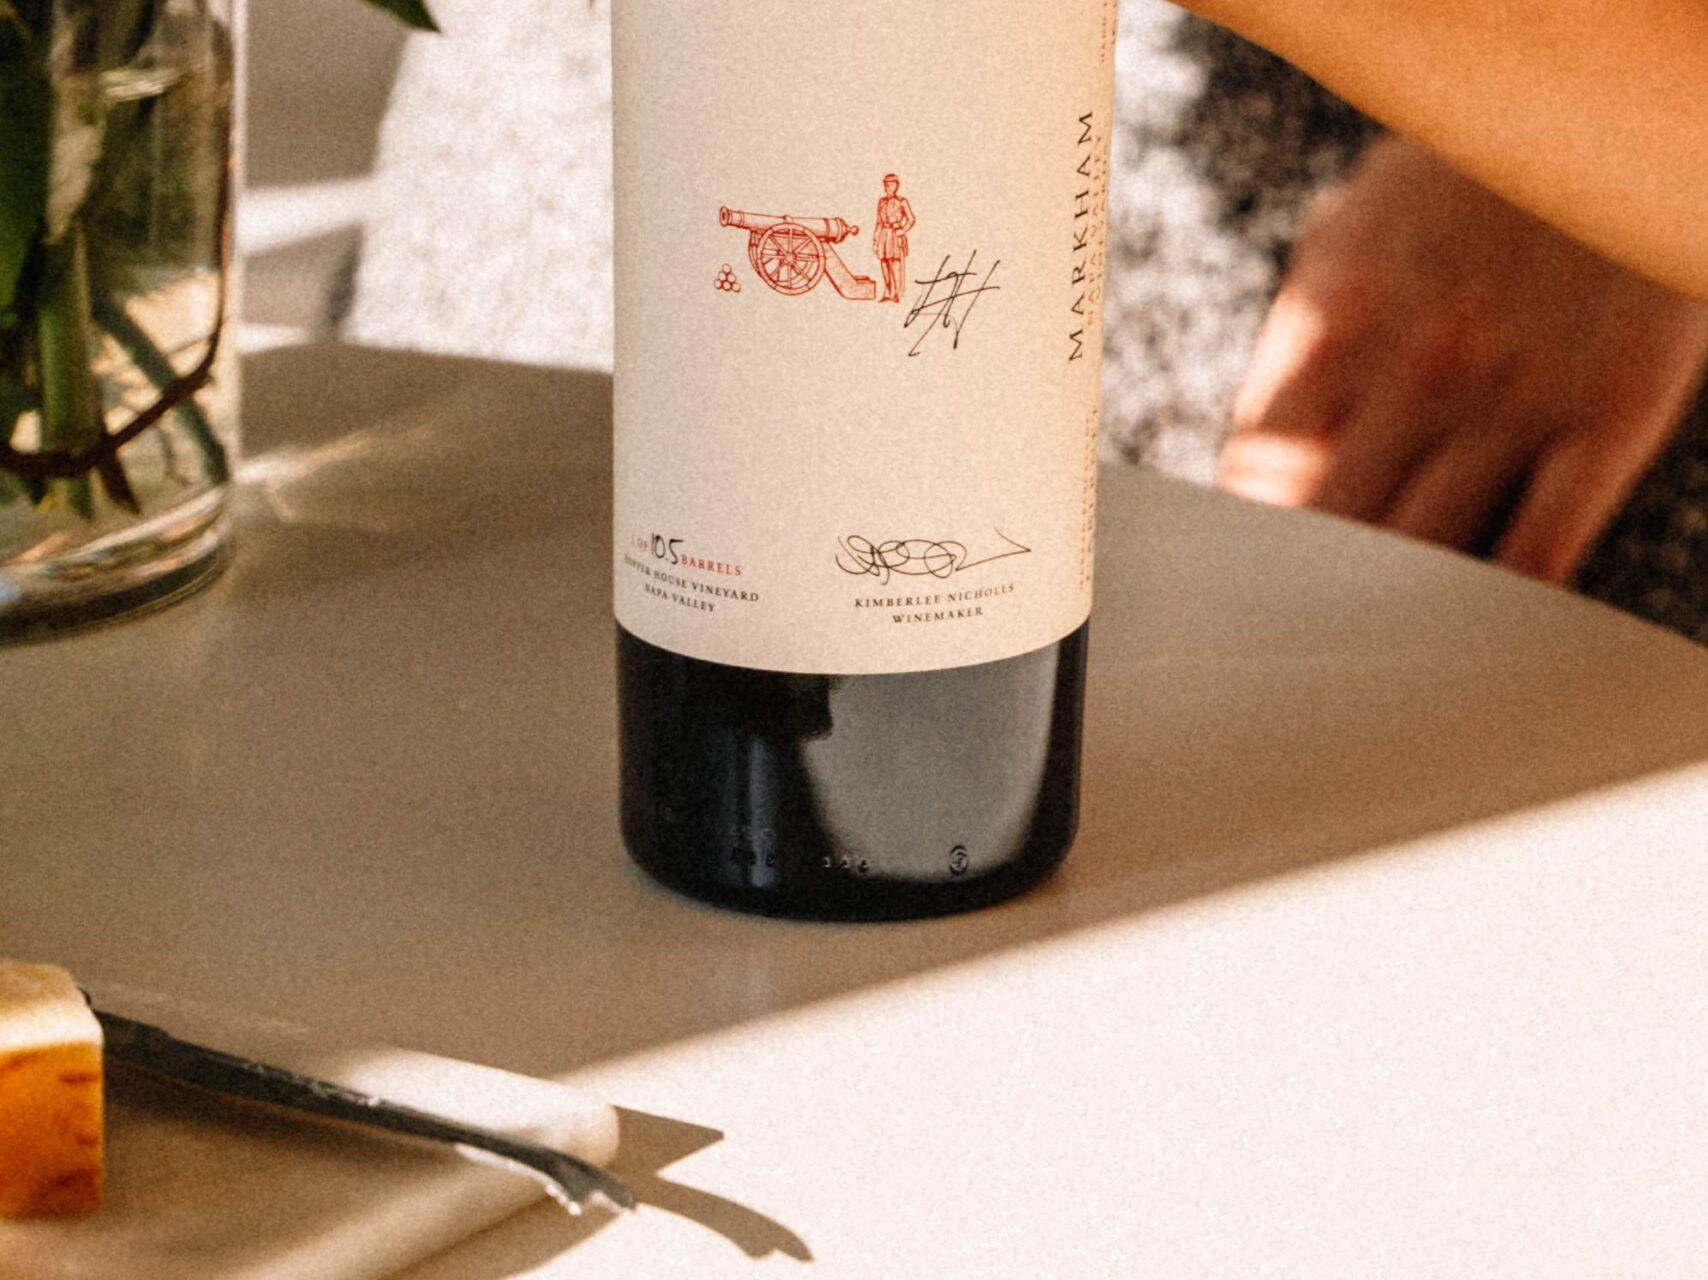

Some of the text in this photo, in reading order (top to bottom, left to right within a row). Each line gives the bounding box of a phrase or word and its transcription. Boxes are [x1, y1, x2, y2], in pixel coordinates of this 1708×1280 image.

[1068, 111, 1093, 362] MARKHAM
[681, 554, 742, 576] BARRELS
[644, 583, 716, 612] NAPA VALLEY
[654, 569, 687, 589] HOUSE
[692, 581, 760, 602] VINEYARD
[855, 583, 1015, 608] KIMBERLEE NICHOLLS
[892, 606, 983, 624] WINEMAKER
